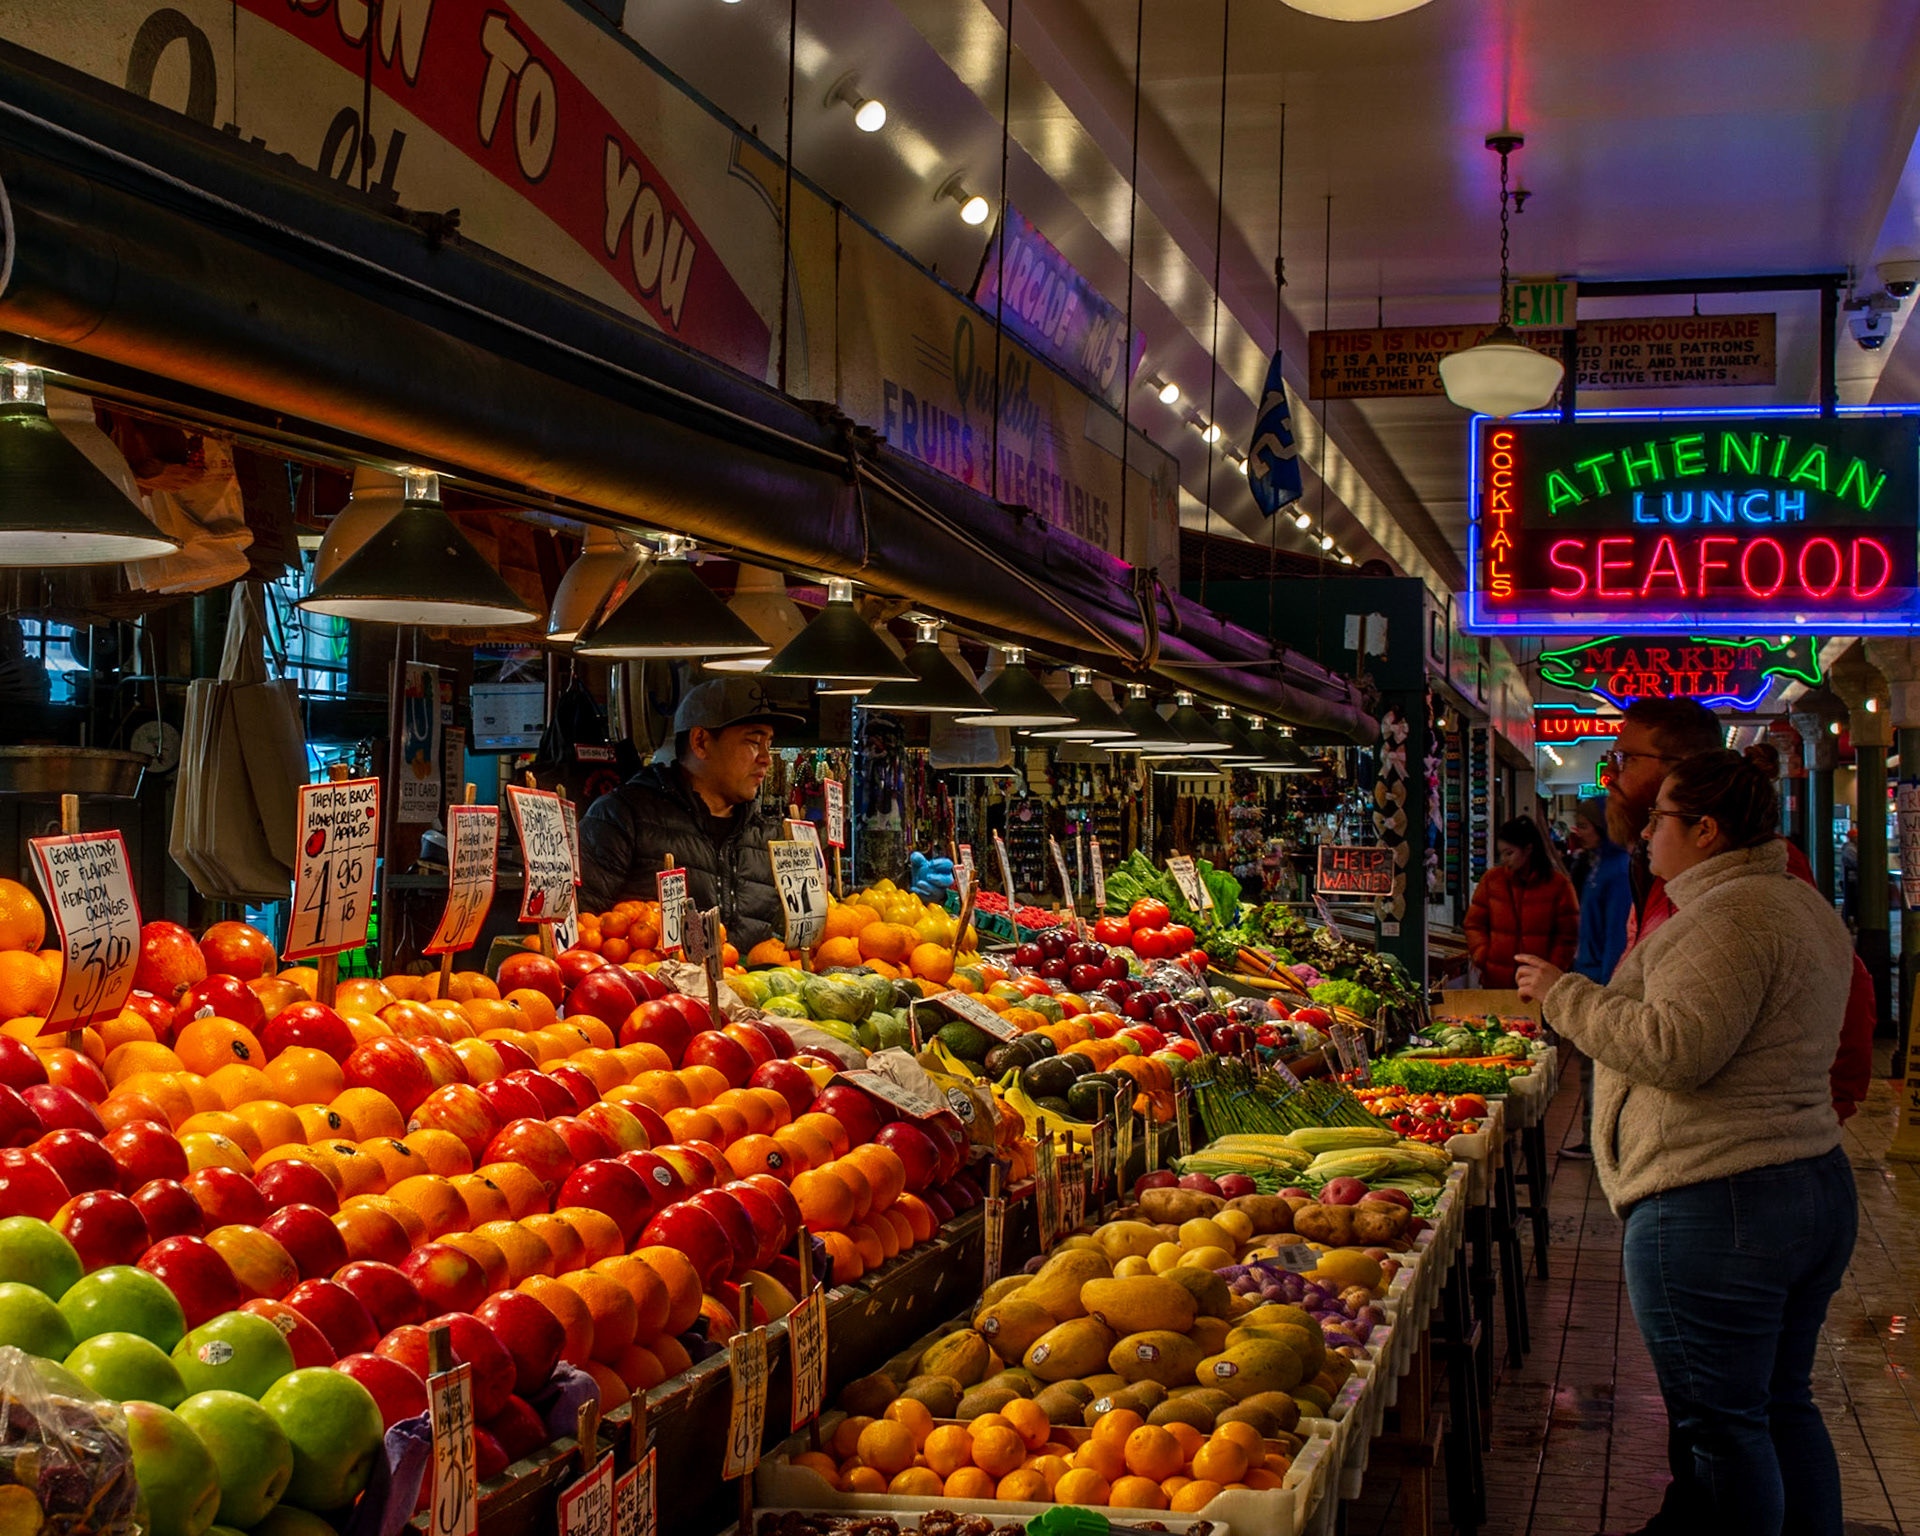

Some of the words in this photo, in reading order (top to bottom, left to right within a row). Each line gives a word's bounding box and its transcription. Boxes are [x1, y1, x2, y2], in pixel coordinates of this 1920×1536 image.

[478, 9, 557, 184] TO
[603, 135, 697, 331] YOU
[991, 234, 1079, 351] ARCADE
[1514, 284, 1567, 326] EXIT
[1321, 332, 1371, 352] THIS
[1383, 332, 1402, 351] IS
[1415, 331, 1463, 350] NOT
[1597, 320, 1760, 343] THOROUGHFARE
[1344, 354, 1358, 365] IS
[1367, 353, 1378, 365] A
[1386, 351, 1453, 364] PRIVAT
[1610, 344, 1640, 356] FOR
[1649, 343, 1672, 355] THE
[1681, 340, 1755, 354] PATRONS
[1321, 368, 1338, 380] OF
[1344, 367, 1369, 378] THE
[1376, 365, 1408, 377] PIKE
[1648, 356, 1675, 369] AND
[1681, 356, 1704, 367] THE
[1709, 354, 1760, 366] FAIRLEY
[1338, 378, 1424, 392] INVESTMENT
[883, 380, 973, 484] FRUITS
[1000, 445, 1109, 553] VEGETABLES
[1545, 431, 1888, 516] ATHENIAN
[1491, 432, 1515, 597] COCKTAILS
[1633, 490, 1806, 524] LUNCH
[1549, 537, 1892, 597] SEAFOOD
[1584, 646, 1763, 672] MARKET
[1607, 670, 1741, 697] GRILL
[1543, 718, 1622, 734] LOWER
[404, 782, 417, 797] EBT
[420, 782, 438, 797] CARD
[308, 809, 361, 828] HONEYCRISP
[334, 821, 370, 841] APPLES
[521, 808, 550, 834] COSMIC
[50, 838, 116, 865] GENERATIONS
[532, 831, 563, 857] CRISP
[1333, 850, 1385, 871] HELP
[56, 870, 70, 888] OF
[1322, 872, 1392, 892] WANTED
[62, 884, 110, 909] HEIRLOOM
[86, 898, 129, 922] ORANGES
